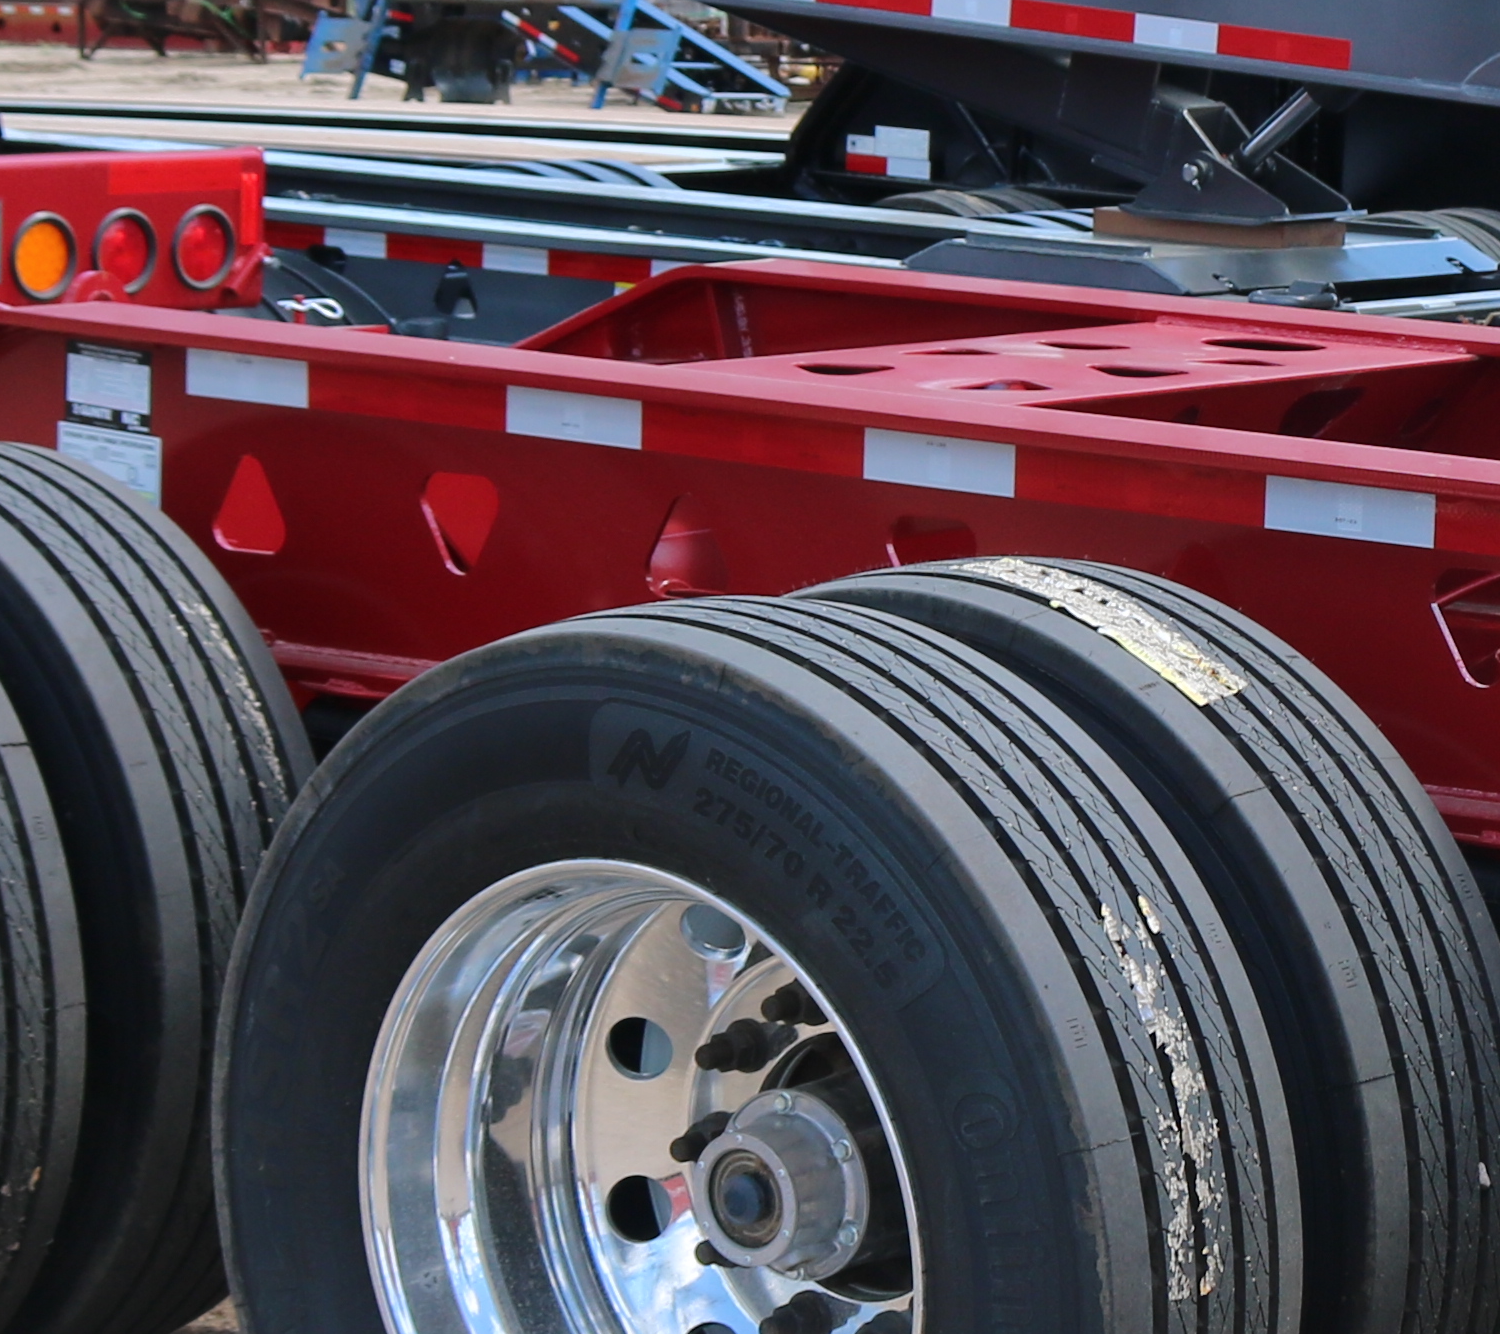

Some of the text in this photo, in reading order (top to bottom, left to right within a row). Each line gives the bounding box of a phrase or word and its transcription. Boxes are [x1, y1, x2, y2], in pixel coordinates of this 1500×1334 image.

[692, 786, 897, 989] 275/70 R 22.5
